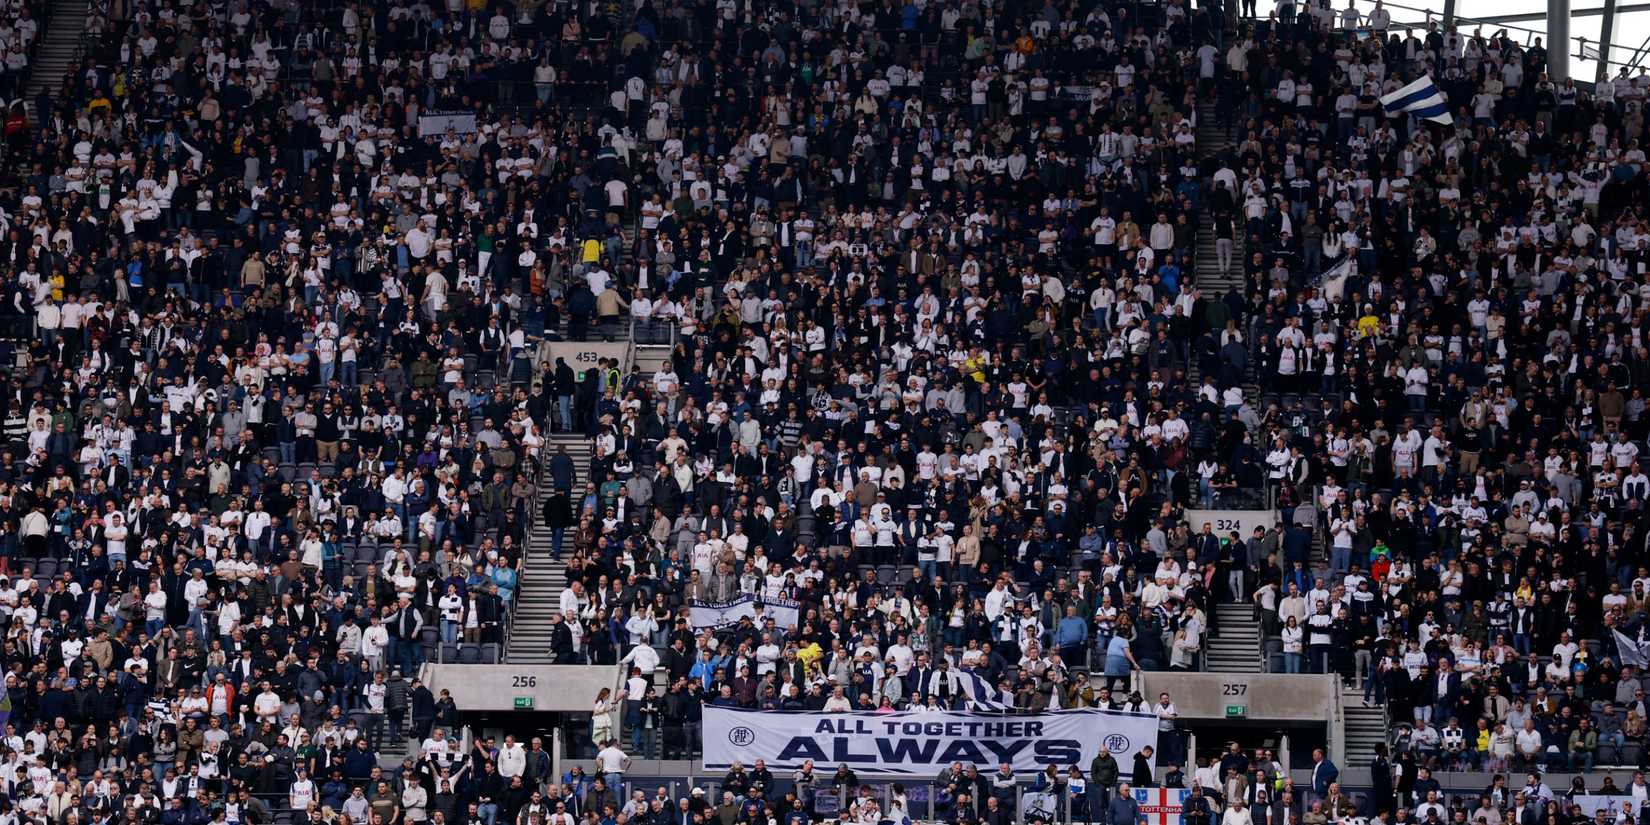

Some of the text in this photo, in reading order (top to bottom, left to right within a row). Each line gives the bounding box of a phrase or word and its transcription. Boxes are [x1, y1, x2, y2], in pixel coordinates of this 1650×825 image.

[575, 352, 598, 363] 453
[1217, 519, 1240, 530] 324
[512, 676, 537, 688] 256
[1223, 684, 1247, 696] 257
[815, 719, 1044, 738] ALL TOGETHER
[776, 736, 1081, 765] ALWAYS
